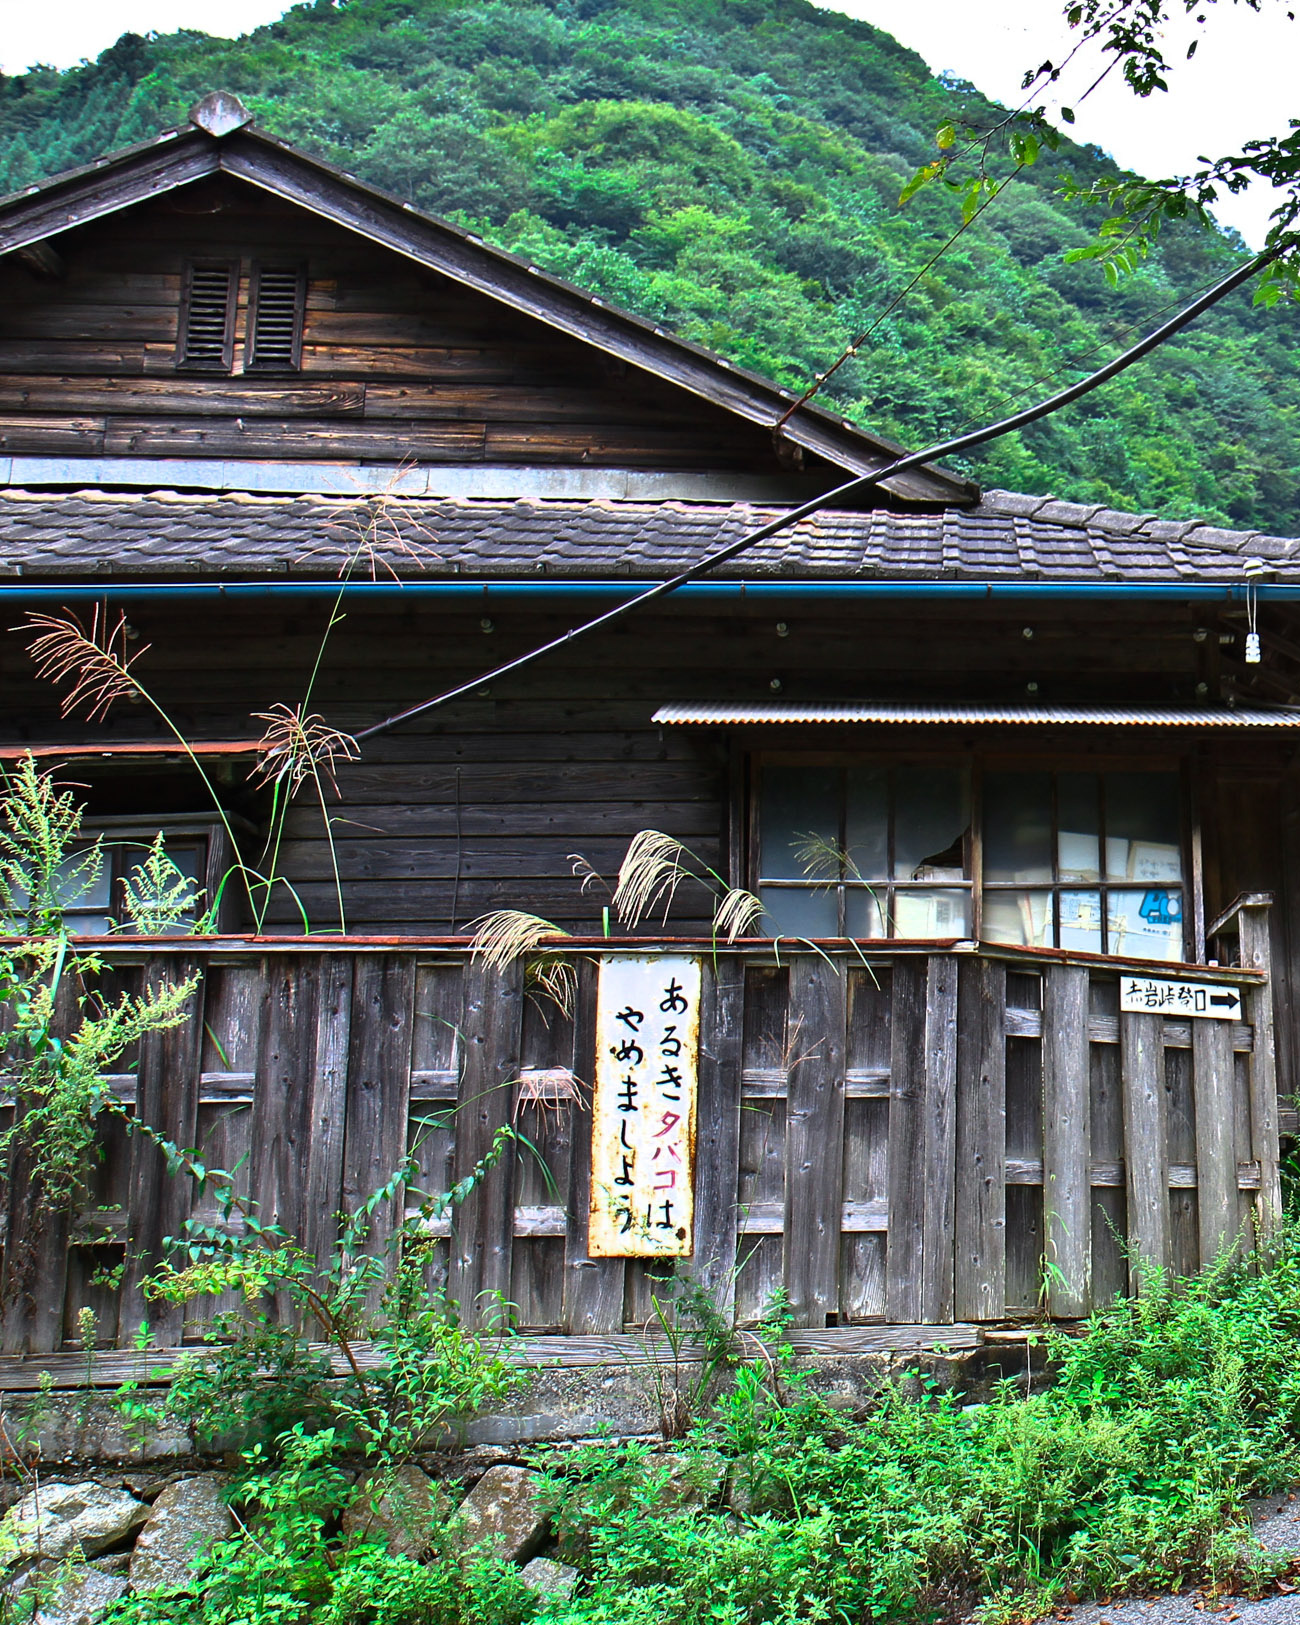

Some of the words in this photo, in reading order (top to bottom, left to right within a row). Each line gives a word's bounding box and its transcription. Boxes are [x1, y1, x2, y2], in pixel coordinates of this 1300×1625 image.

[646, 976, 689, 1230] あるきタバコは
